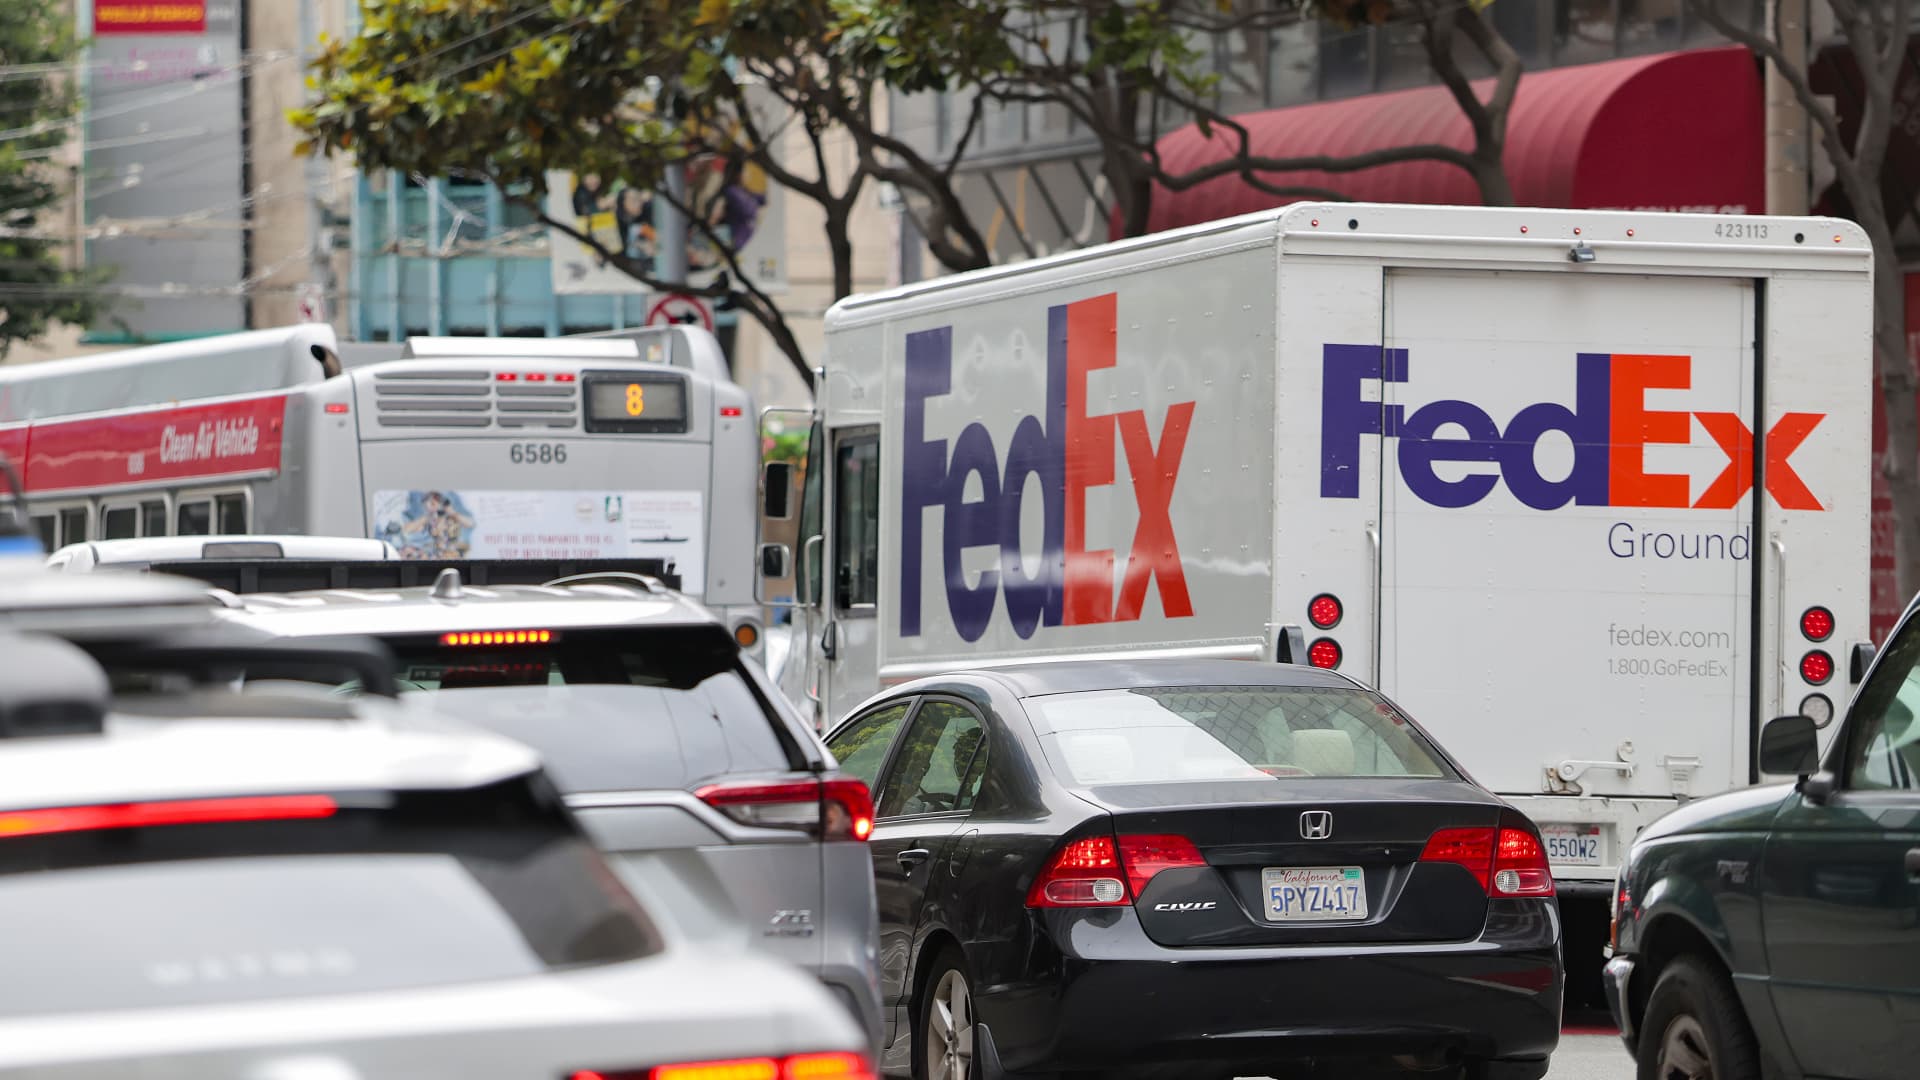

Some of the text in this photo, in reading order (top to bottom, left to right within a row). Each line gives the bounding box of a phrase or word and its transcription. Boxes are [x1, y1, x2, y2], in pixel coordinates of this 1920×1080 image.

[1714, 223, 1769, 239] 423113
[625, 383, 645, 416] 8
[160, 425, 195, 464] Clean
[195, 421, 215, 460] Air
[215, 416, 259, 458] Vehicle
[1320, 343, 1828, 512] FedEx
[510, 443, 568, 464] 6586
[900, 292, 1197, 643] FedEx
[1608, 522, 1750, 561] Ground
[1608, 623, 1730, 649] fedex.com
[1608, 658, 1728, 677] 1.800.GoFedEx
[1543, 837, 1597, 858] 550W2
[1283, 869, 1341, 885] California
[1154, 902, 1217, 912] CIVIC
[1269, 886, 1359, 912] 5PYZ417
